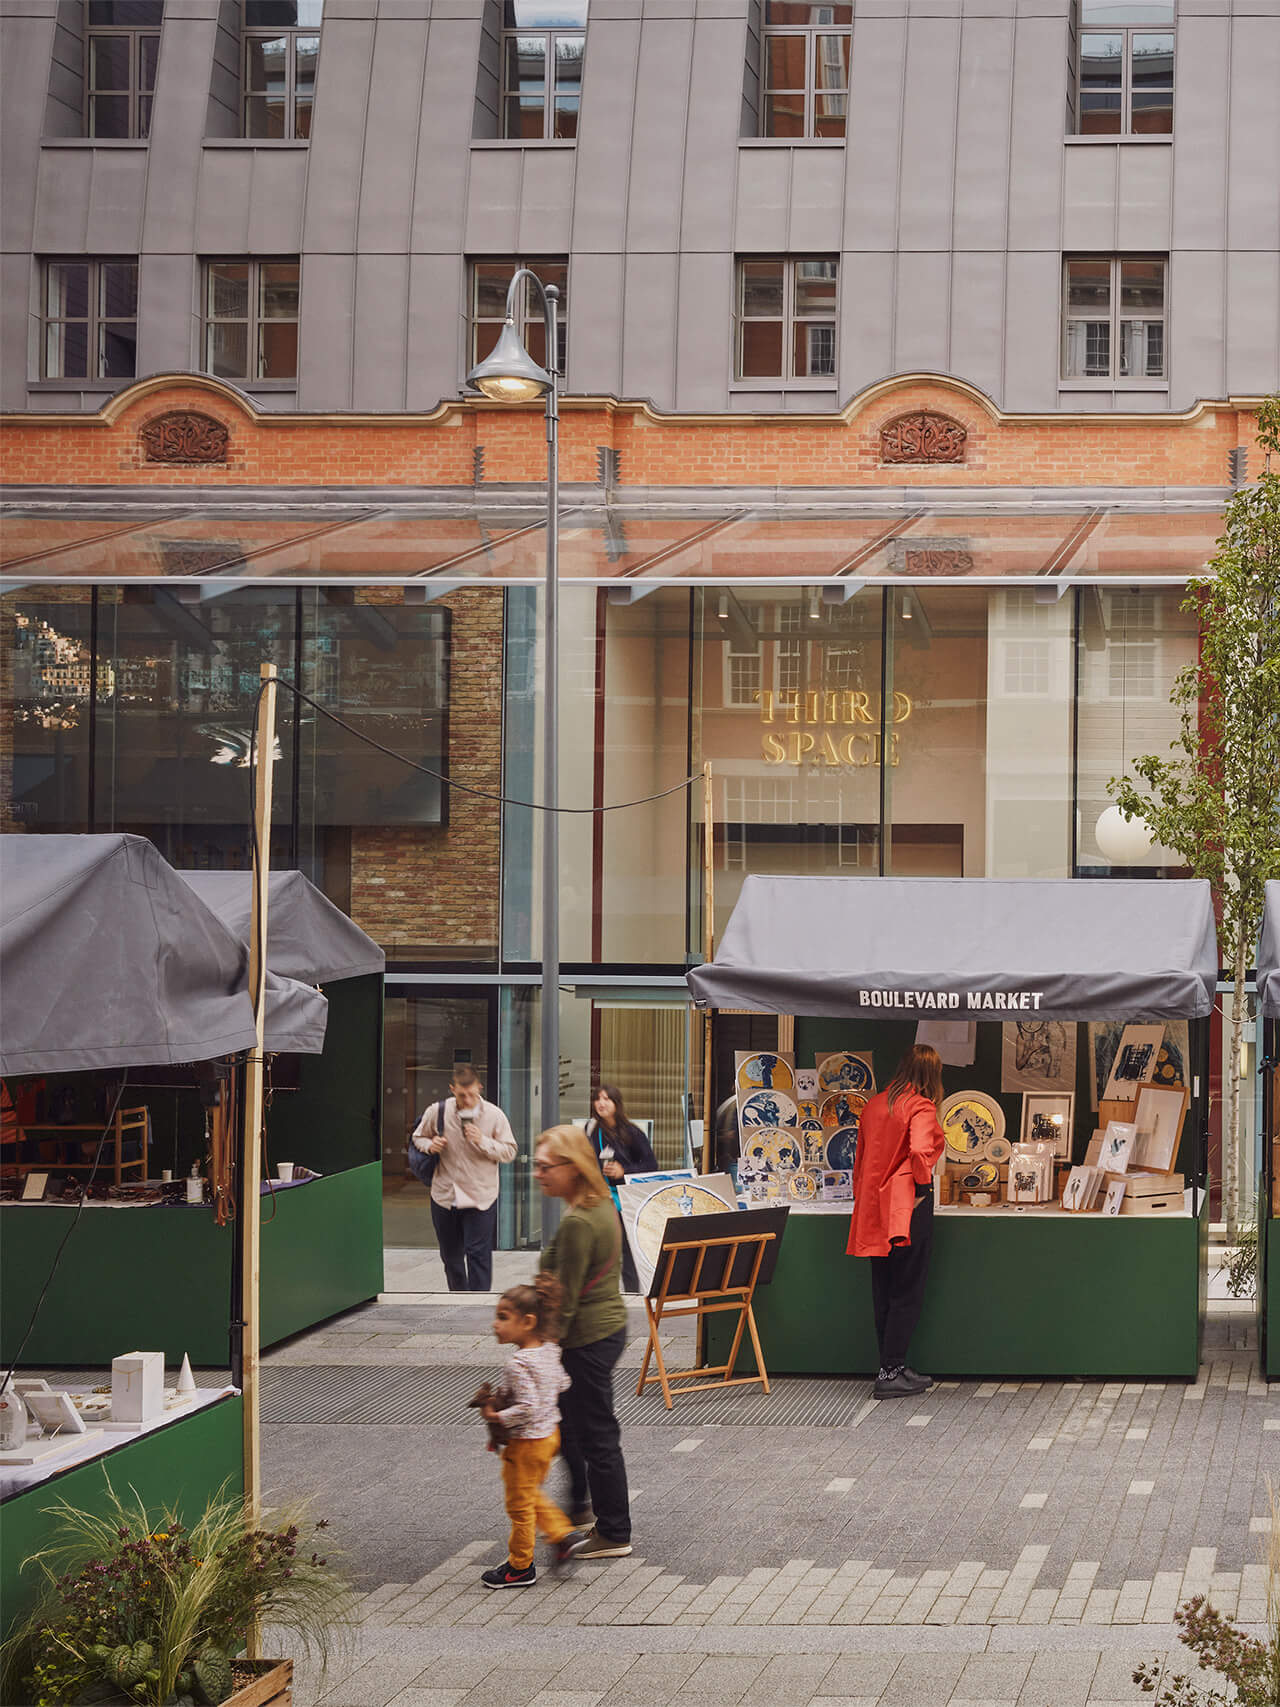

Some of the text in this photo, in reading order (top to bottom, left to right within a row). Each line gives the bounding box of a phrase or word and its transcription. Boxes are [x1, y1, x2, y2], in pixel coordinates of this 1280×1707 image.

[752, 690, 912, 723] THIRD
[760, 731, 900, 767] SPACE
[859, 990, 1044, 1010] BOULEVARD MARKET
